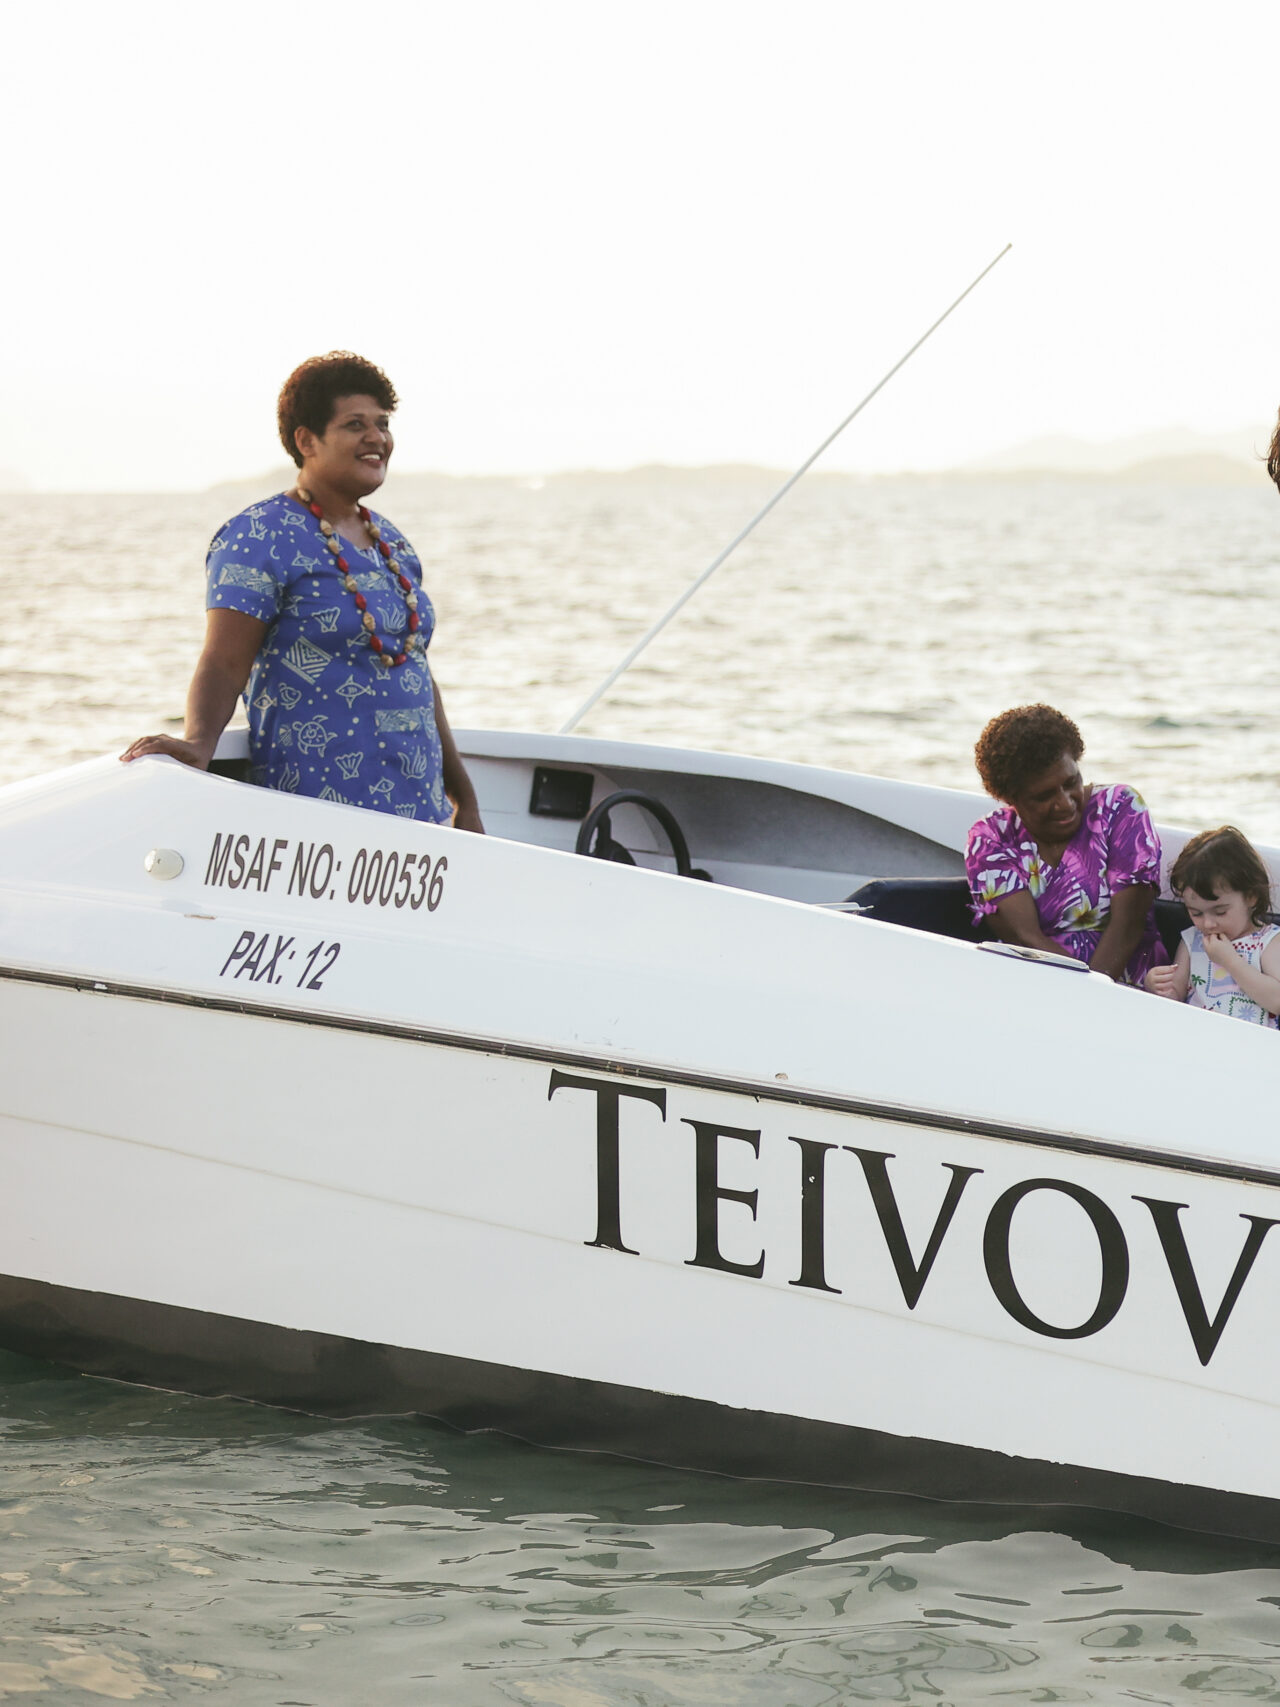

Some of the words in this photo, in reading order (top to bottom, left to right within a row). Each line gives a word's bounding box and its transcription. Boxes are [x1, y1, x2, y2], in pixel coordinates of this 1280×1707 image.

[204, 832, 288, 893] MSAF
[287, 840, 341, 900] NO:
[347, 848, 448, 912] 000536
[219, 930, 296, 985] PAX:
[297, 941, 341, 990] 12
